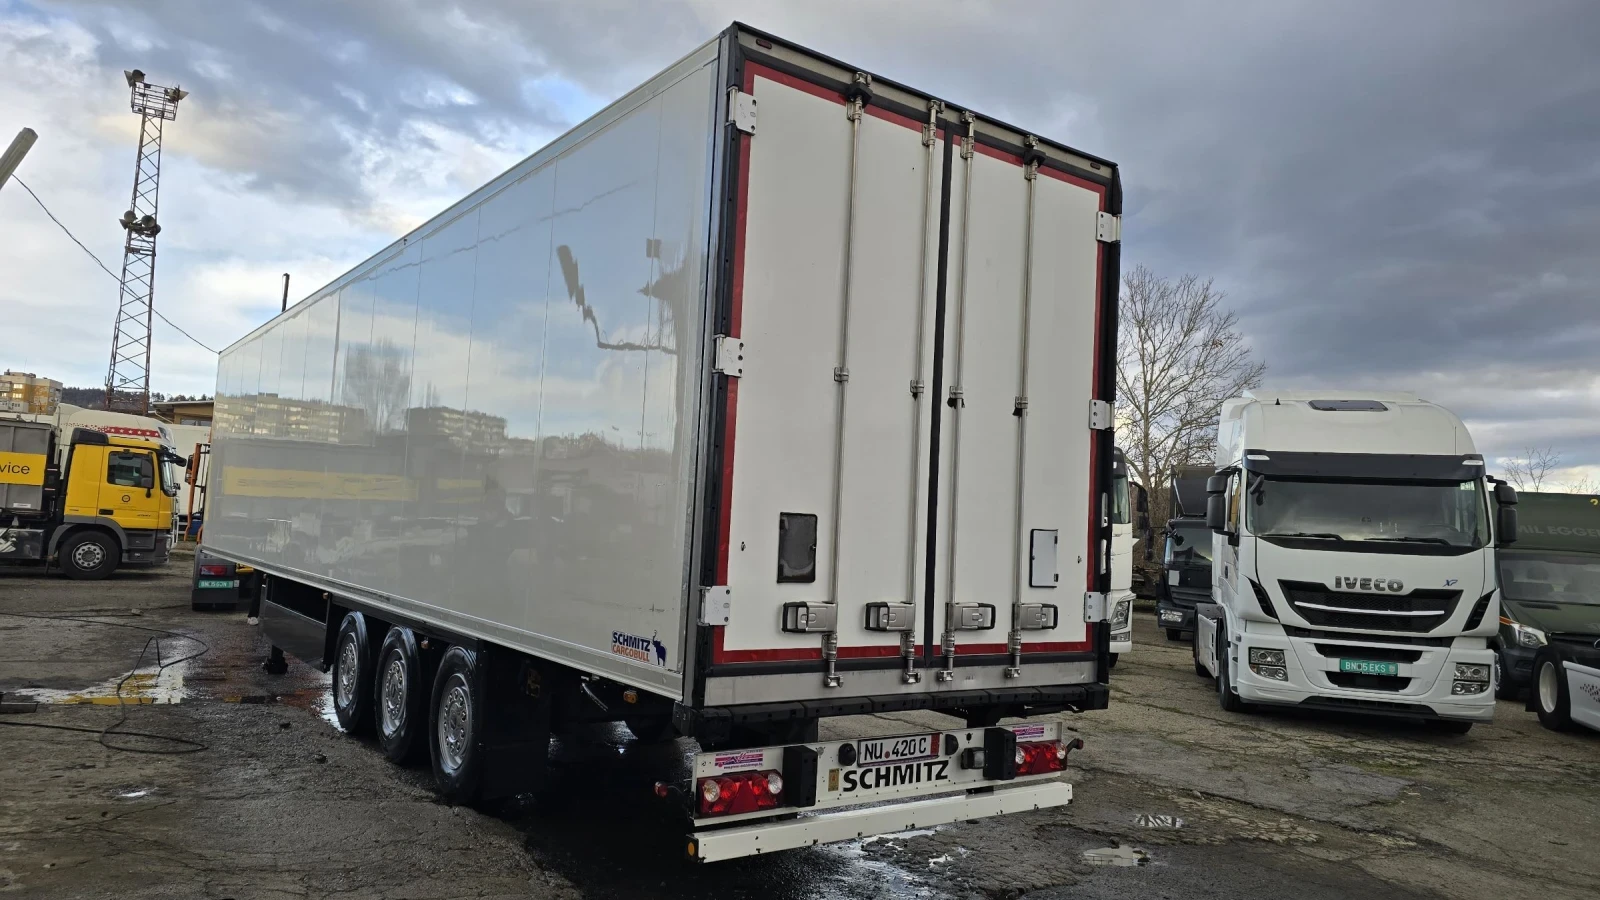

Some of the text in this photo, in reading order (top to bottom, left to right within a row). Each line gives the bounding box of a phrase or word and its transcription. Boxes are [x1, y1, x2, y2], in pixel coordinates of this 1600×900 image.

[0, 462, 30, 475] vice
[1335, 576, 1404, 592] IVECO
[612, 631, 651, 652] SCHMITZ
[612, 644, 650, 662] CARGOBULL
[1369, 663, 1386, 673] EKS
[864, 742, 883, 761] NU
[843, 760, 949, 792] SCHMITZ
